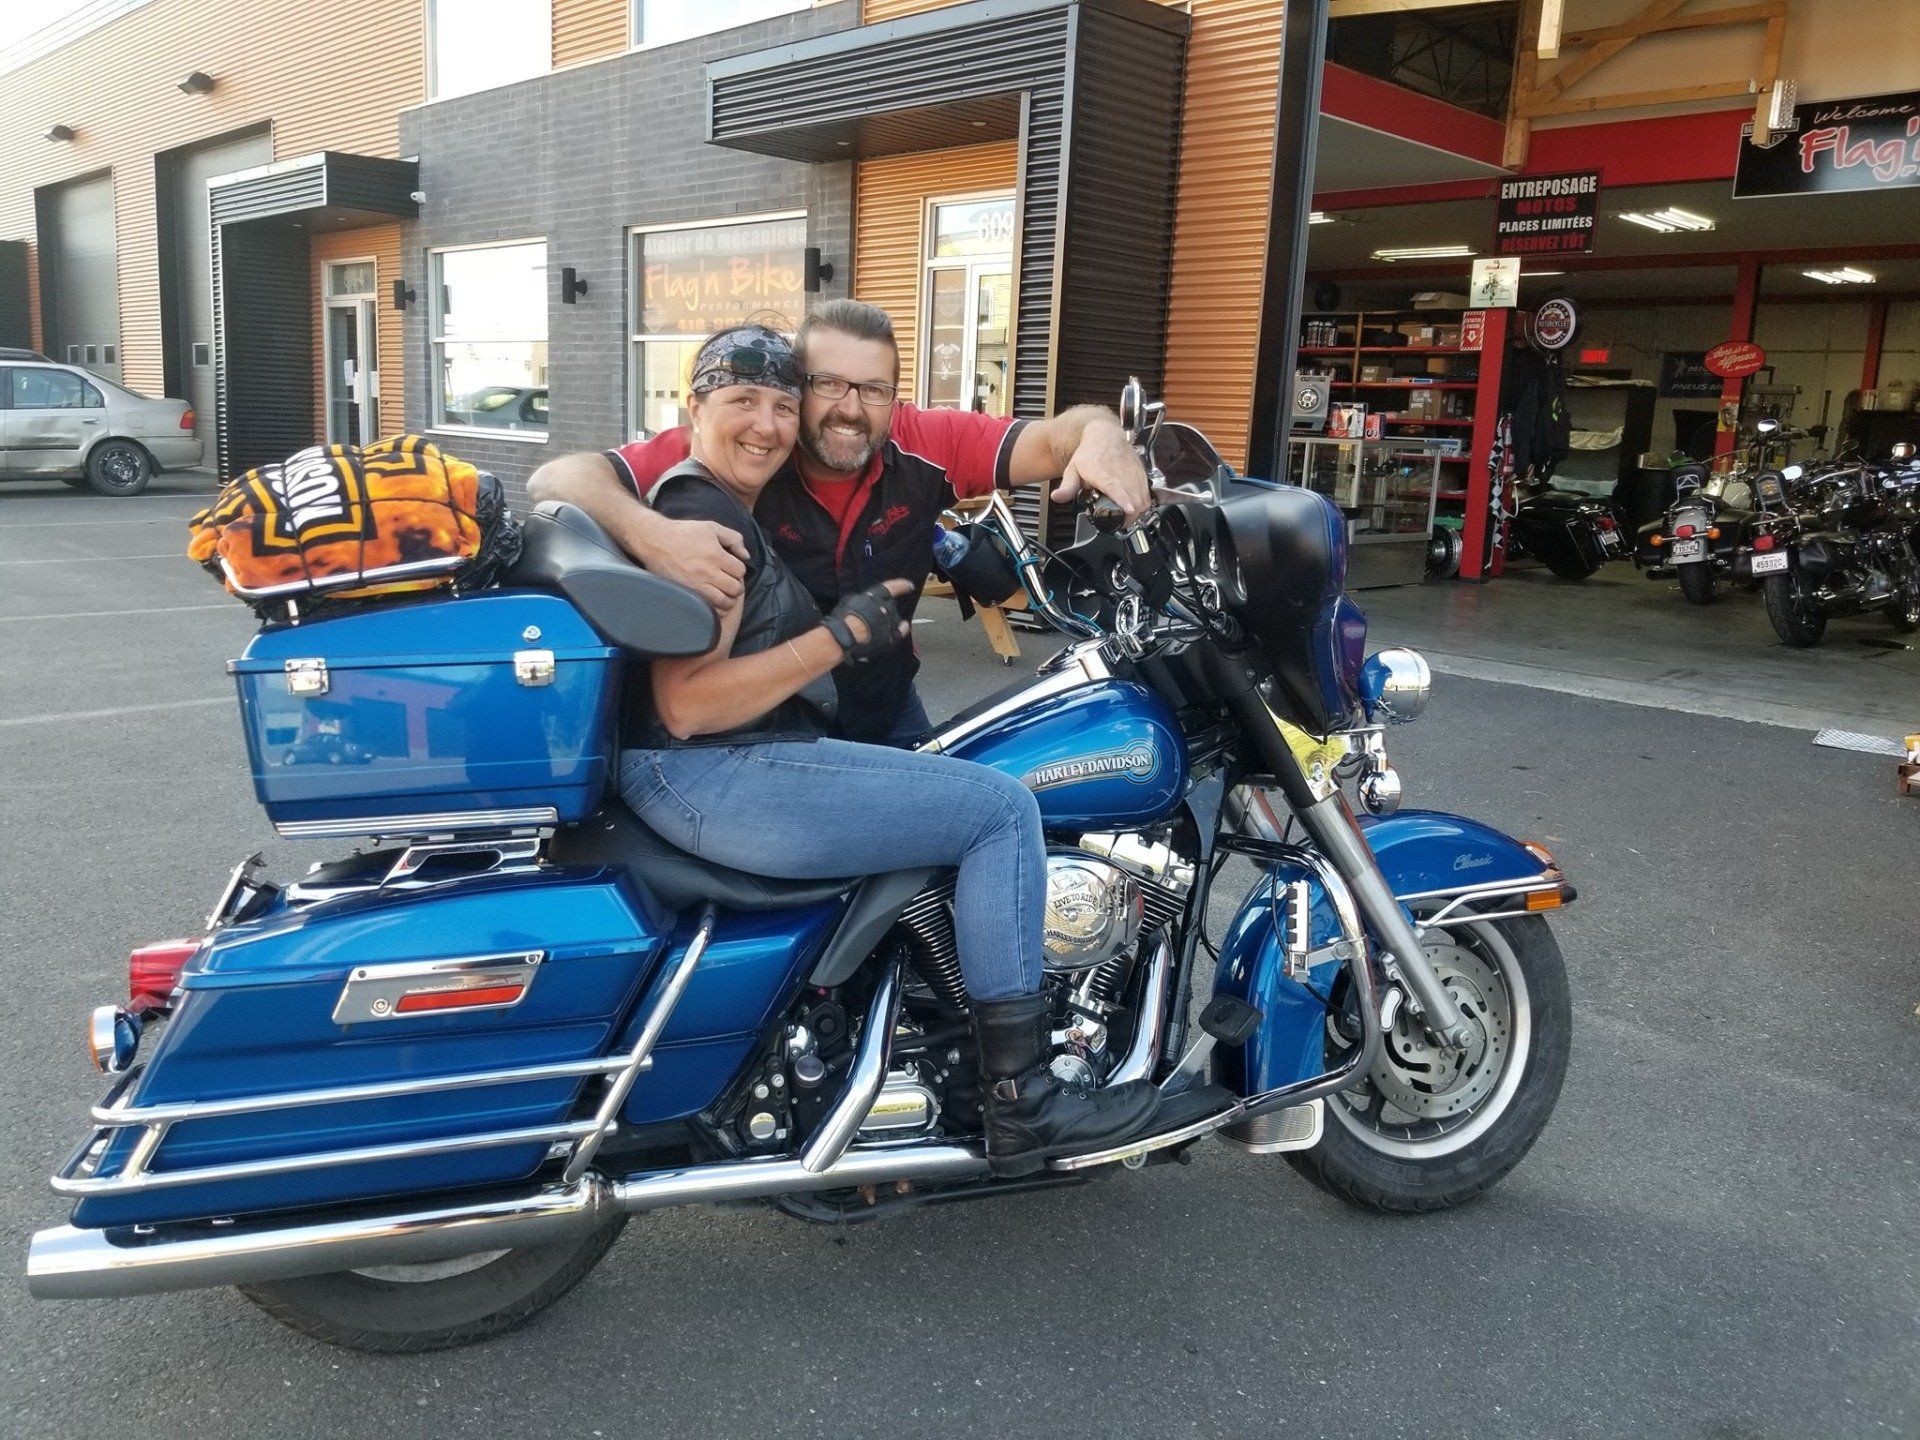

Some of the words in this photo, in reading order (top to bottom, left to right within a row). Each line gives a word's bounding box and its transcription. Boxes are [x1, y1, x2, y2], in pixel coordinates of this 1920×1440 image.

[1814, 103, 1915, 124] Welcome
[1501, 176, 1597, 199] ENTREPOSAGE
[1516, 196, 1577, 214] MOTOS
[1499, 220, 1540, 232] PLACES
[1541, 215, 1593, 230] LIMITÉES
[644, 236, 691, 255] Atelier
[695, 232, 714, 250] de
[718, 225, 806, 250] mécanique
[1562, 231, 1586, 249] TÔT
[645, 258, 720, 312] Flag'n
[728, 252, 803, 297] Bike
[700, 299, 800, 312] PERFORMANCE
[1053, 895, 1071, 908] LIVE
[1071, 893, 1080, 901] TO
